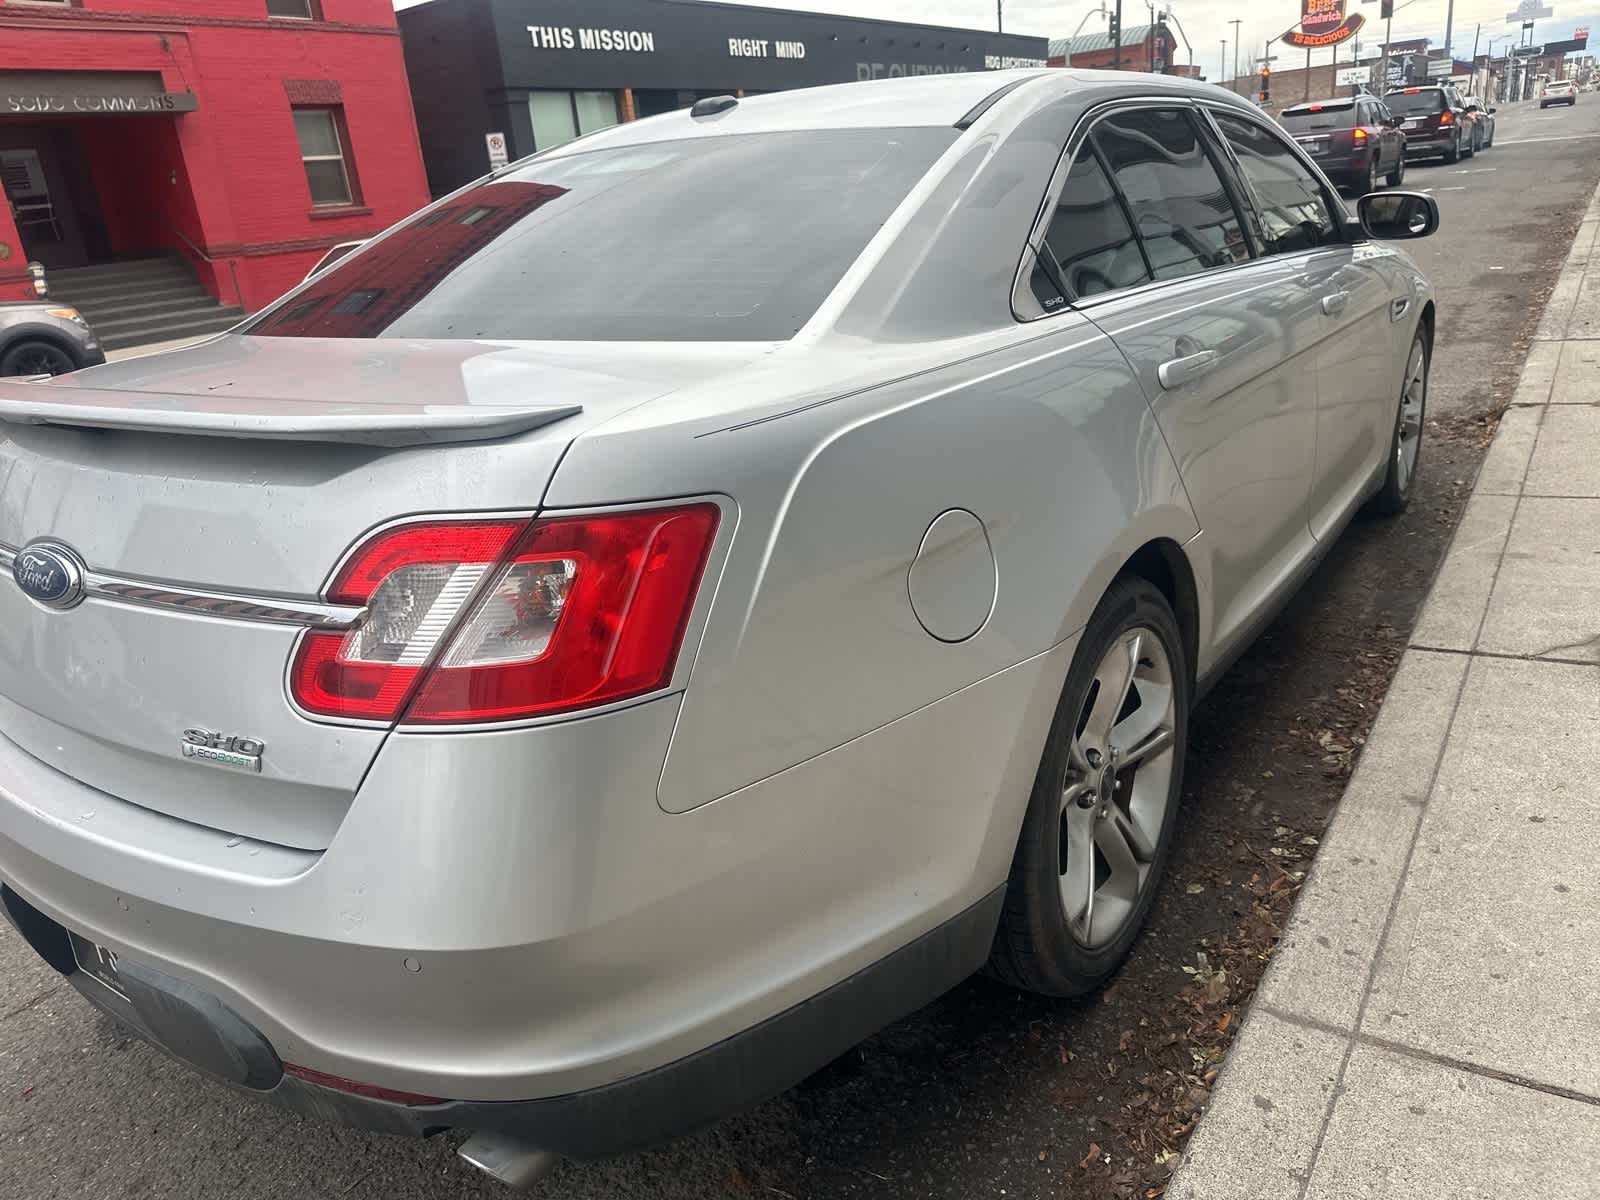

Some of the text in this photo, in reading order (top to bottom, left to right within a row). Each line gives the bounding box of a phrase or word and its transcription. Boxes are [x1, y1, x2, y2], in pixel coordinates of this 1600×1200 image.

[527, 26, 655, 52] THIS MISSION
[1304, 27, 1350, 44] DELICIOUS
[728, 38, 806, 59] RIGHT MIND
[73, 95, 175, 112] COMMONS
[20, 555, 54, 591] Ford
[183, 728, 265, 757] SHO
[197, 748, 252, 767] ECOBOOST
